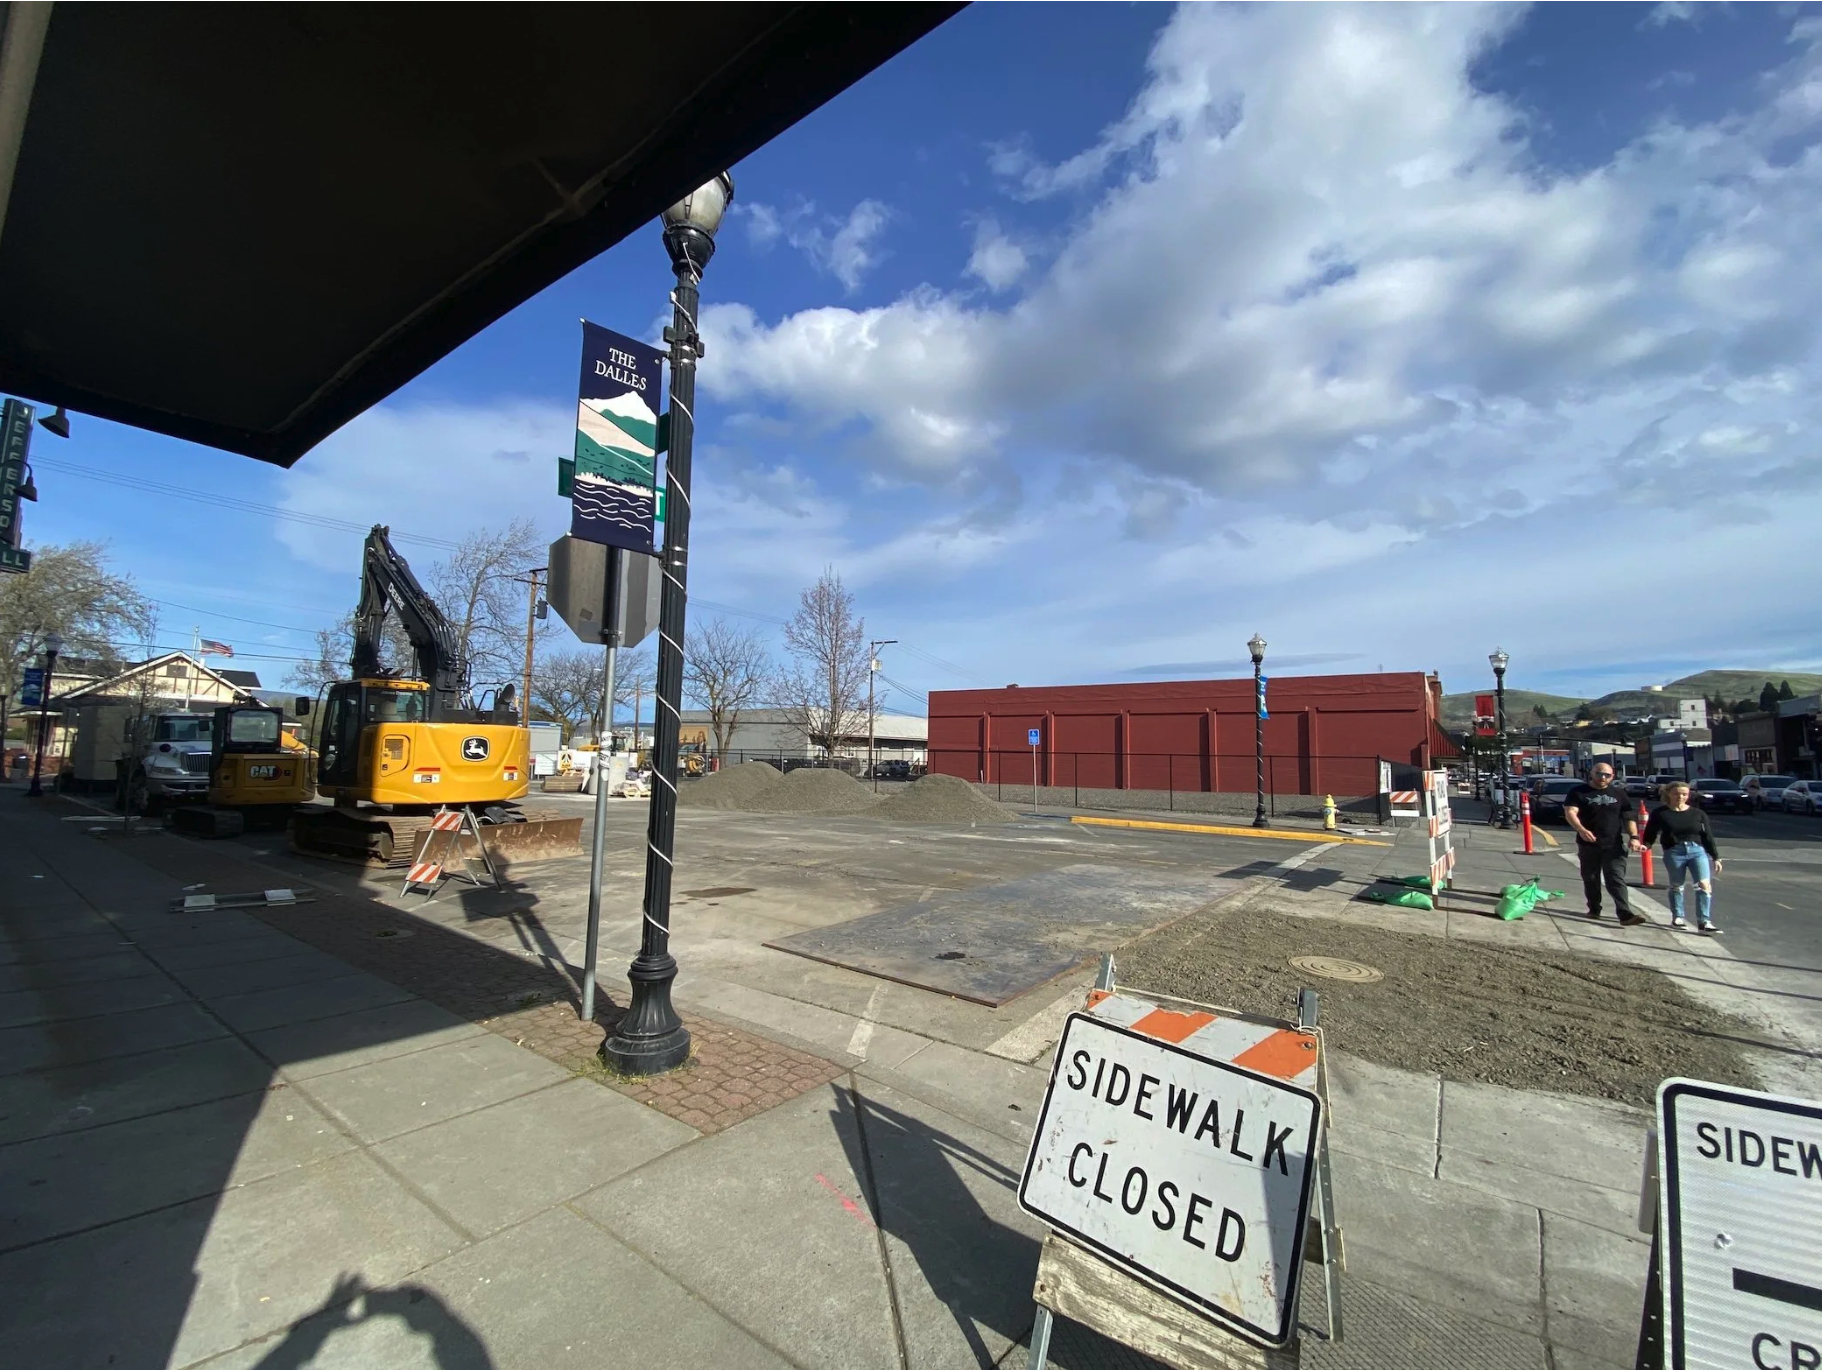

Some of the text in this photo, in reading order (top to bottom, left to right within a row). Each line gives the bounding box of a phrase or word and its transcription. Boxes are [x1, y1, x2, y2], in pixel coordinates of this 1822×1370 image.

[608, 347, 637, 370] THE
[594, 359, 647, 391] DALLES
[250, 765, 276, 778] CAT
[1067, 1049, 1295, 1177] SIDEWALK
[1068, 1142, 1246, 1263] CLOSED
